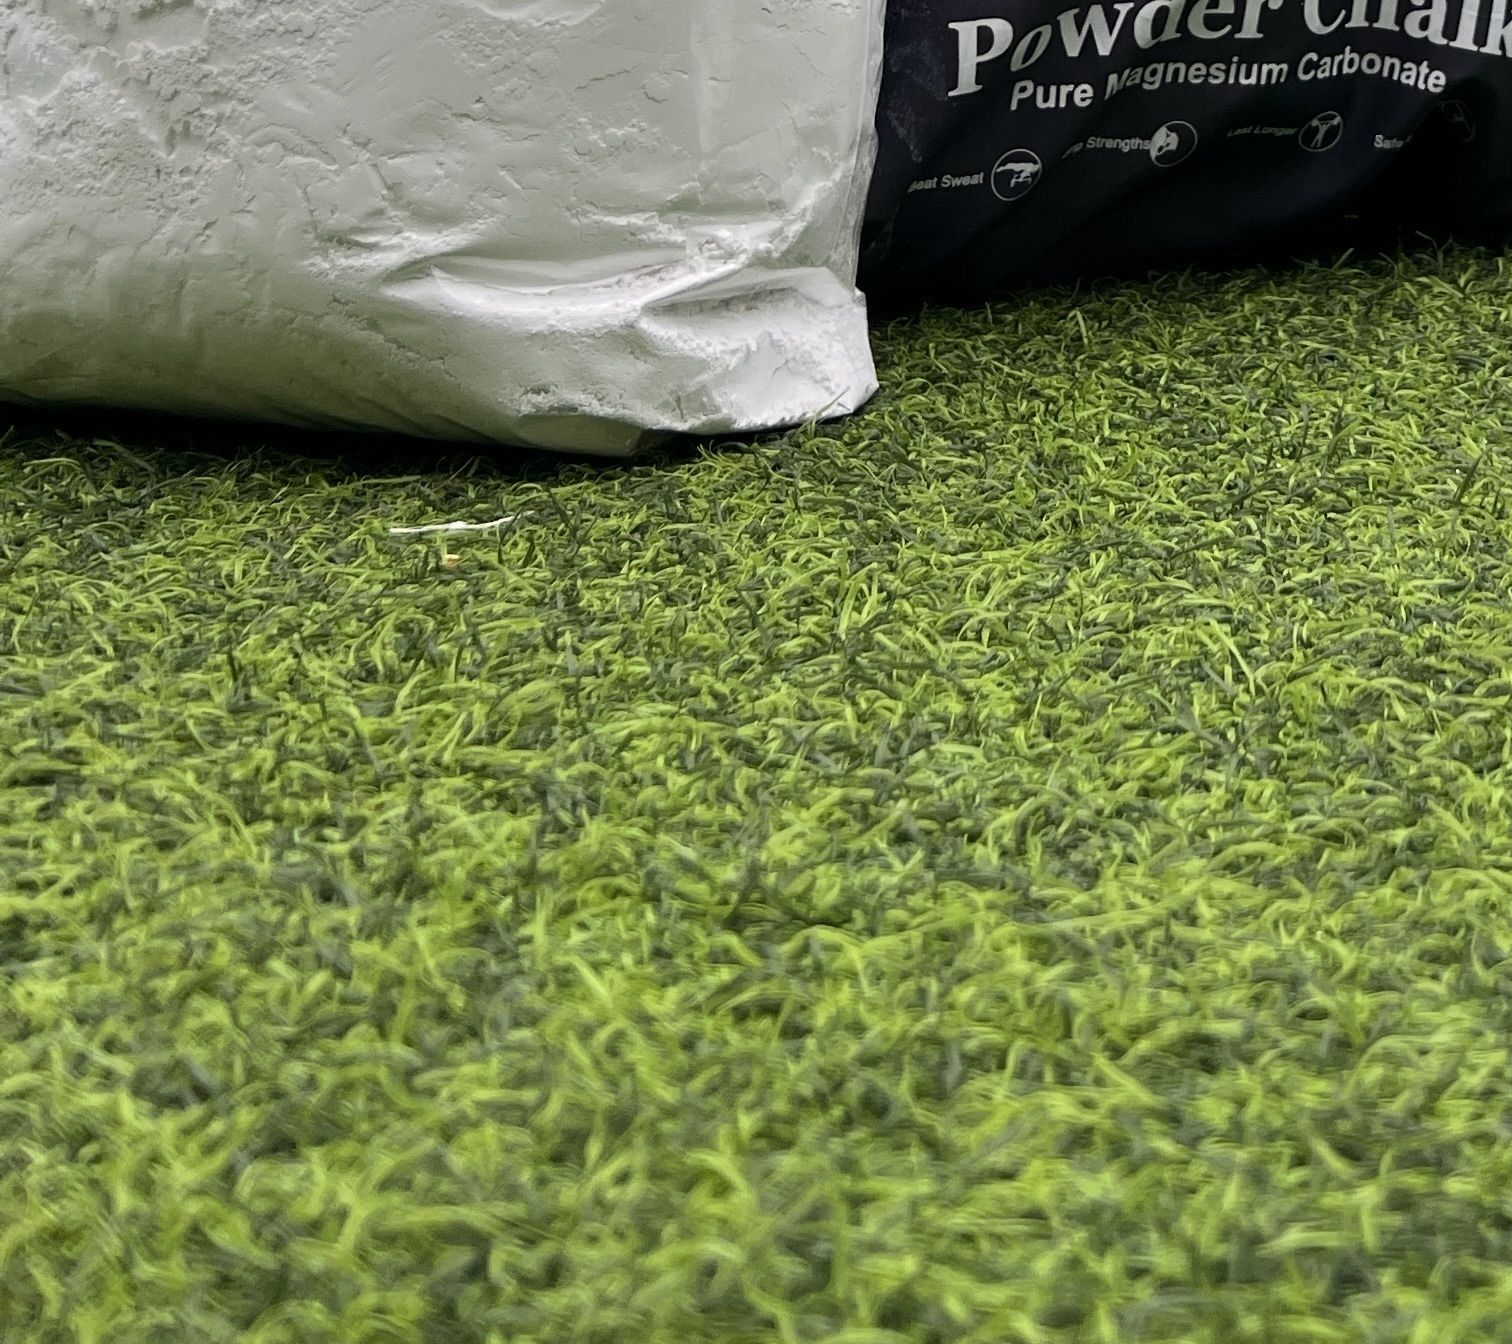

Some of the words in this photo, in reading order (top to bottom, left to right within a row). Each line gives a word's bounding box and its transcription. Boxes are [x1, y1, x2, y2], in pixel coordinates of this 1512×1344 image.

[1010, 77, 1094, 111] Pure
[1105, 55, 1288, 100] Magnesium
[1297, 45, 1447, 95] Carbonate
[1085, 136, 1152, 153] Strengths
[940, 171, 985, 188] Sweat
